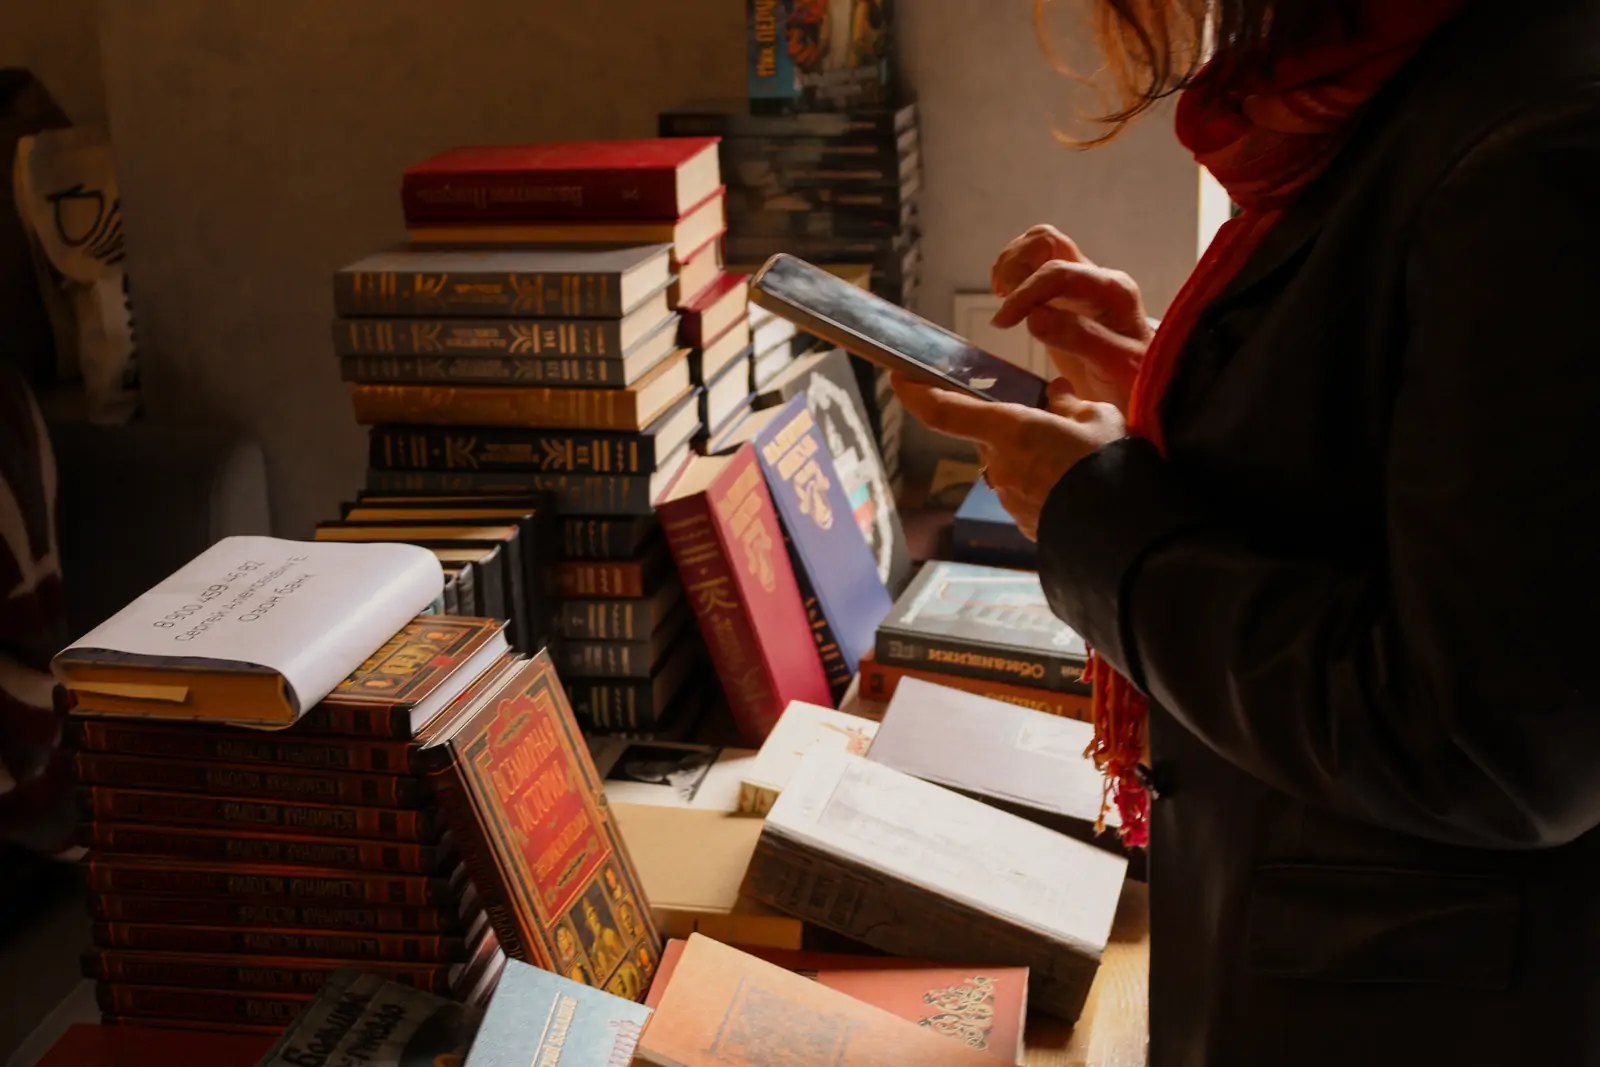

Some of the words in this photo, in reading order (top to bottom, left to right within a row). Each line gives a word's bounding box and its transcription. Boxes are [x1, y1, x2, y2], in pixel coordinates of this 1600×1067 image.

[152, 620, 175, 629] 8
[164, 603, 203, 622] 900
[198, 584, 229, 603] 459
[237, 596, 284, 623] Озон
[273, 574, 318, 595] банк
[174, 608, 229, 642] Сергей
[927, 647, 1045, 679] Обманщики
[491, 715, 560, 803] ВСЕМИРНАЯ
[513, 759, 569, 833] ИСТОРИЯ
